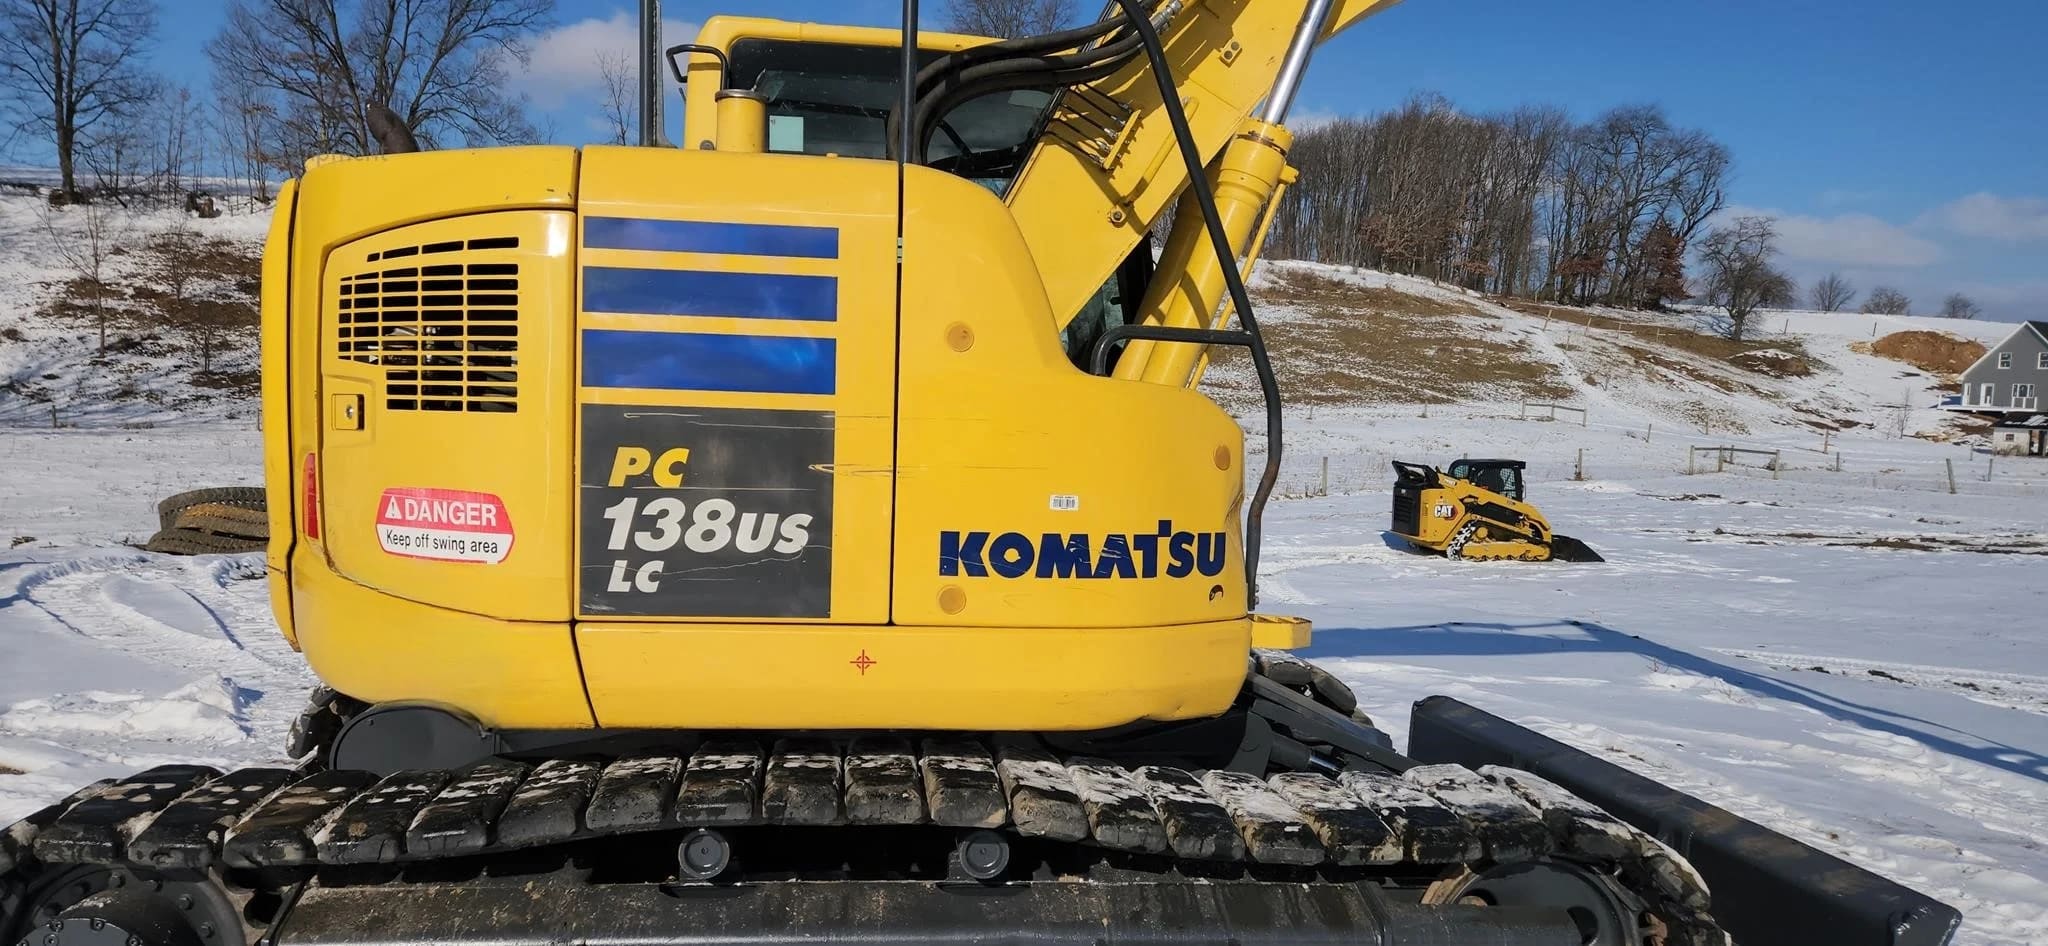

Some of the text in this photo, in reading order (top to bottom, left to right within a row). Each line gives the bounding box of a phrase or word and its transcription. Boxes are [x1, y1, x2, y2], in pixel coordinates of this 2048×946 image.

[607, 446, 690, 489] PC
[404, 498, 497, 527] DANGER
[603, 497, 814, 554] 138US
[1434, 504, 1454, 518] CAT
[386, 529, 498, 554] Keep off swing area
[939, 519, 1227, 579] KOMATSU
[606, 559, 665, 594] LC
